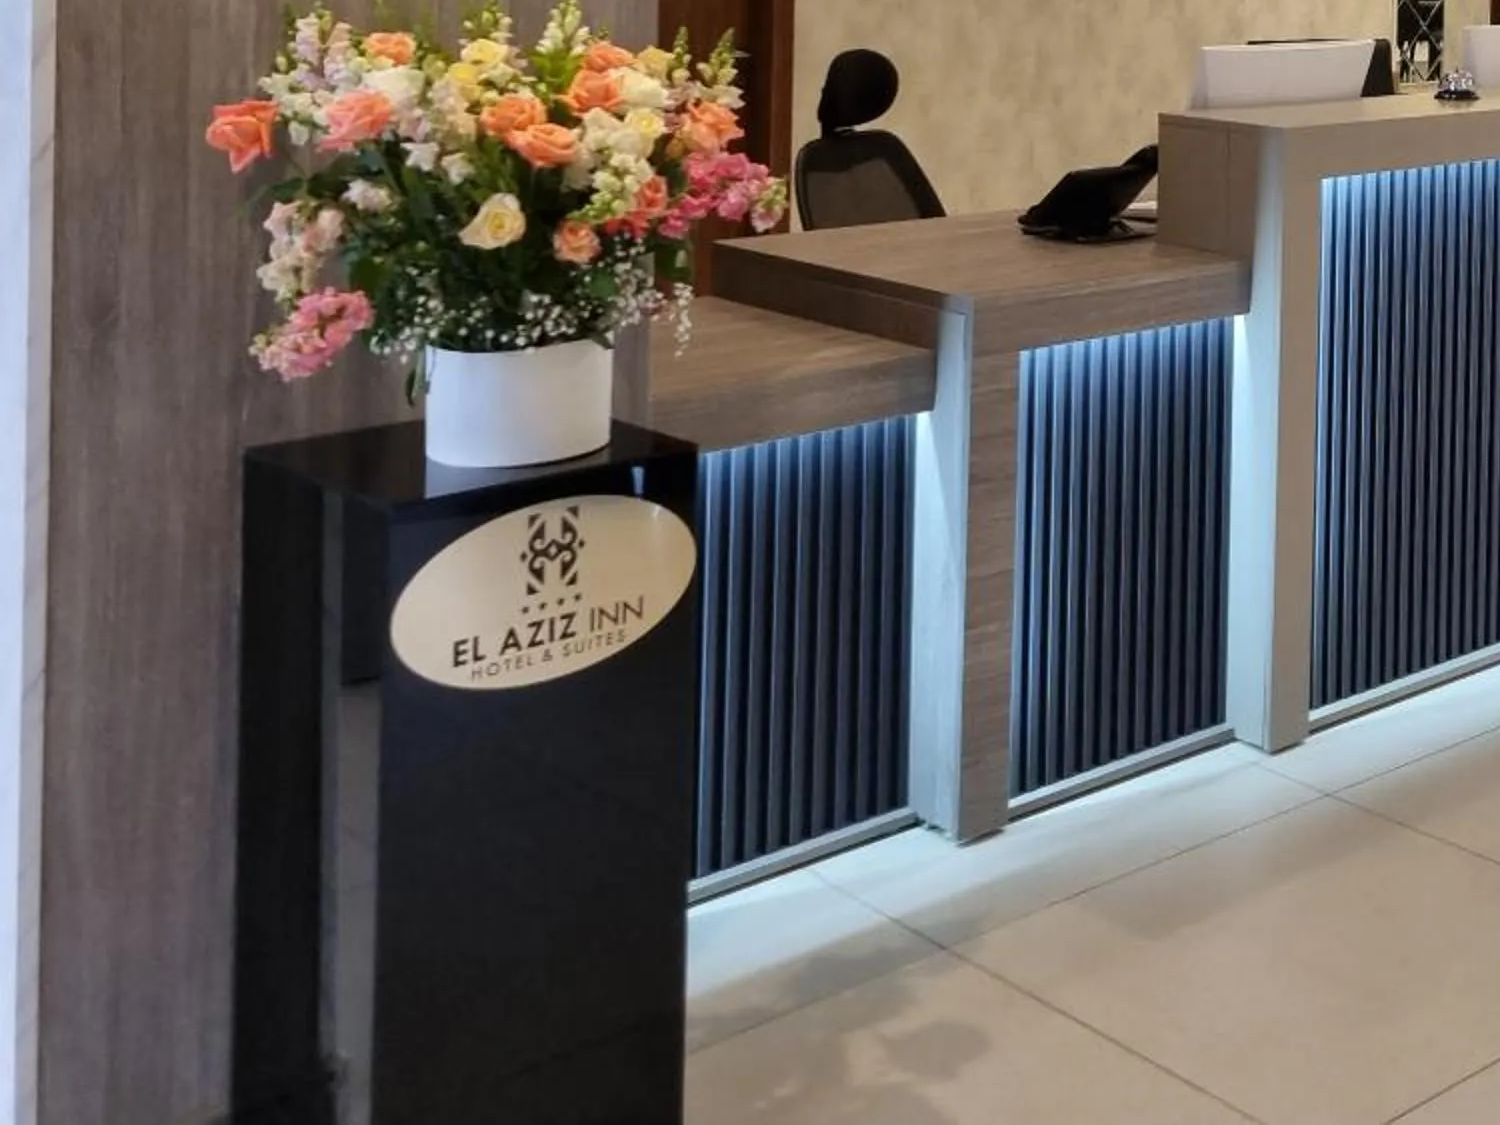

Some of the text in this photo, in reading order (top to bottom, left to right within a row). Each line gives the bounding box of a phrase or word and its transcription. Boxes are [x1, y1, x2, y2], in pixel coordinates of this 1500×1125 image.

[453, 595, 645, 667] EL AZIZ INN
[471, 629, 628, 682] HOTEL & SUITES
